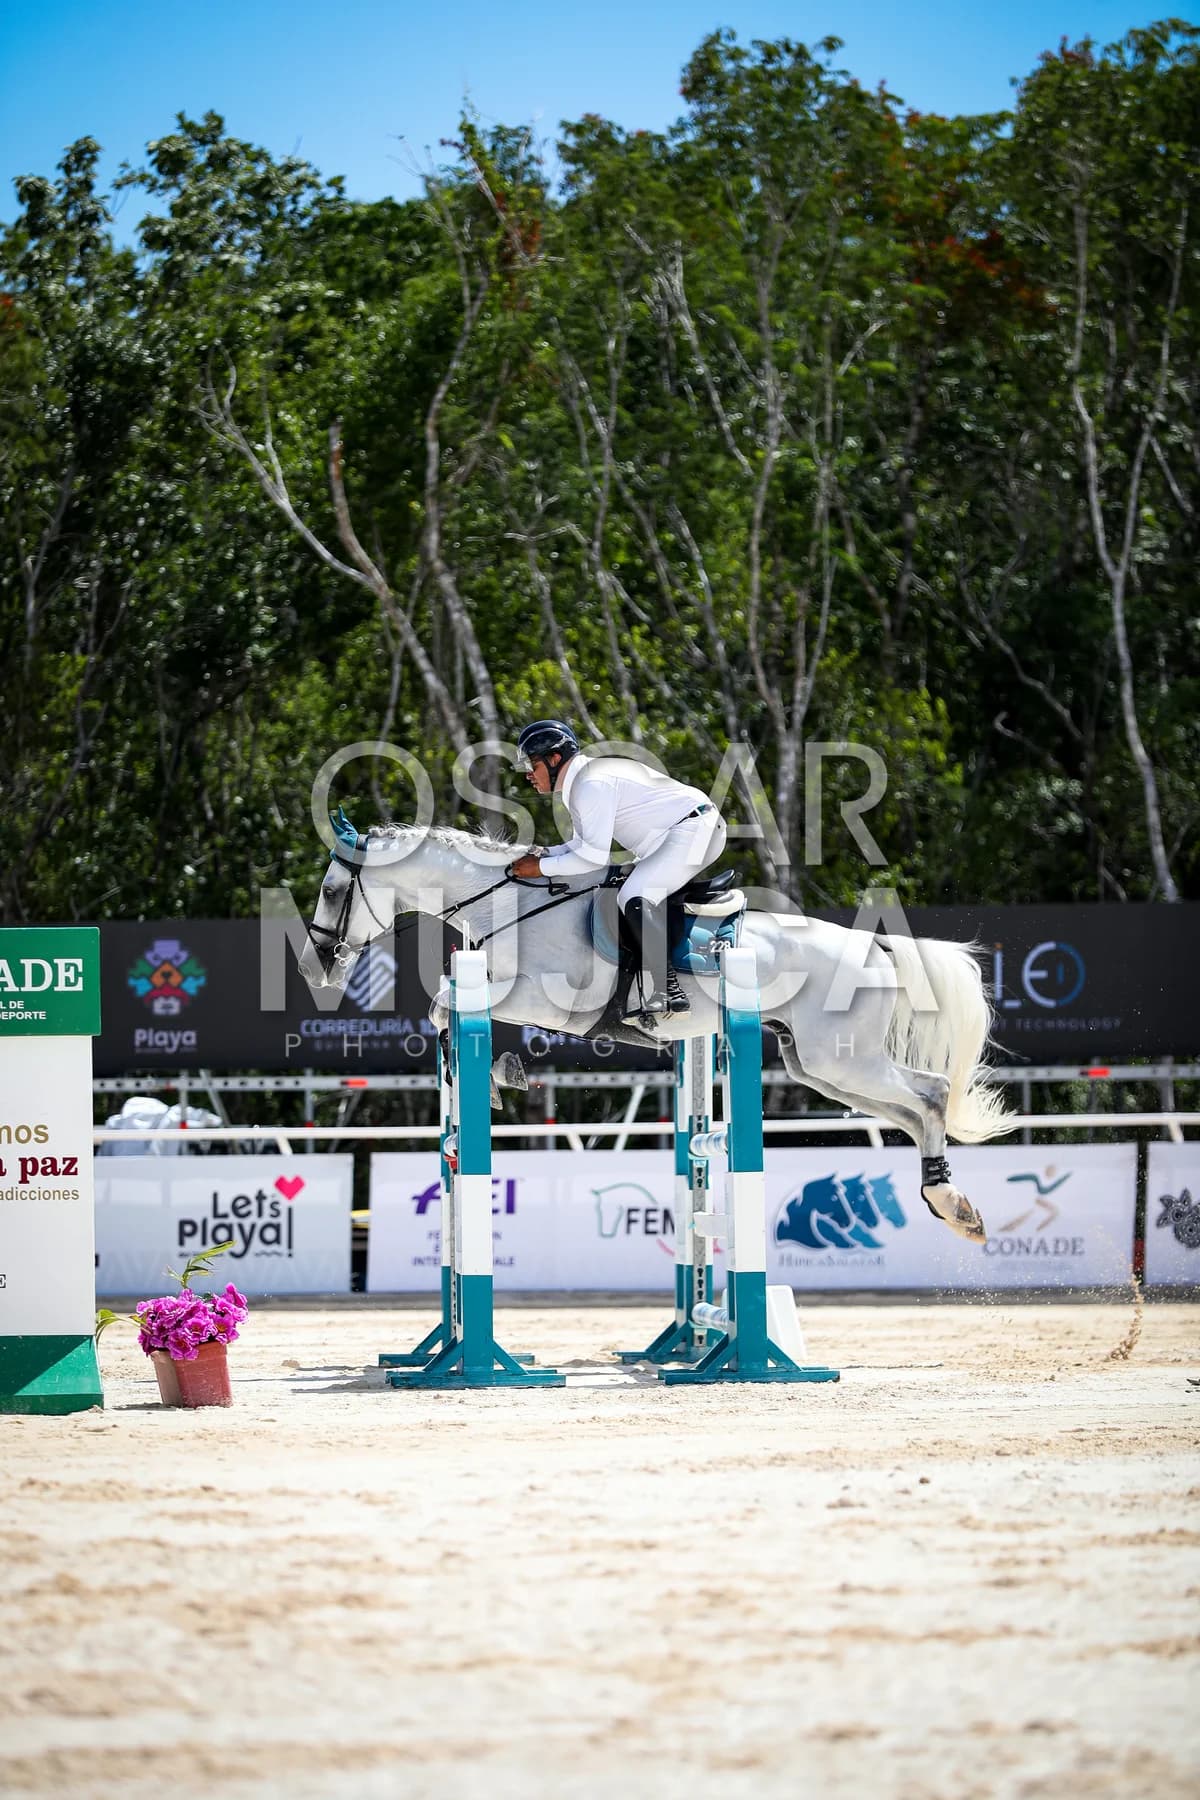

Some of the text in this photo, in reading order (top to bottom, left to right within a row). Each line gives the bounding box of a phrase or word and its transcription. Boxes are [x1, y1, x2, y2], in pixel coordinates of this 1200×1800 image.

[9, 1000, 24, 1009] DE
[0, 1011, 47, 1020] EPORTE
[134, 1028, 197, 1054] Playa
[18, 1156, 79, 1184] paz
[982, 1236, 1085, 1256] CONADE
